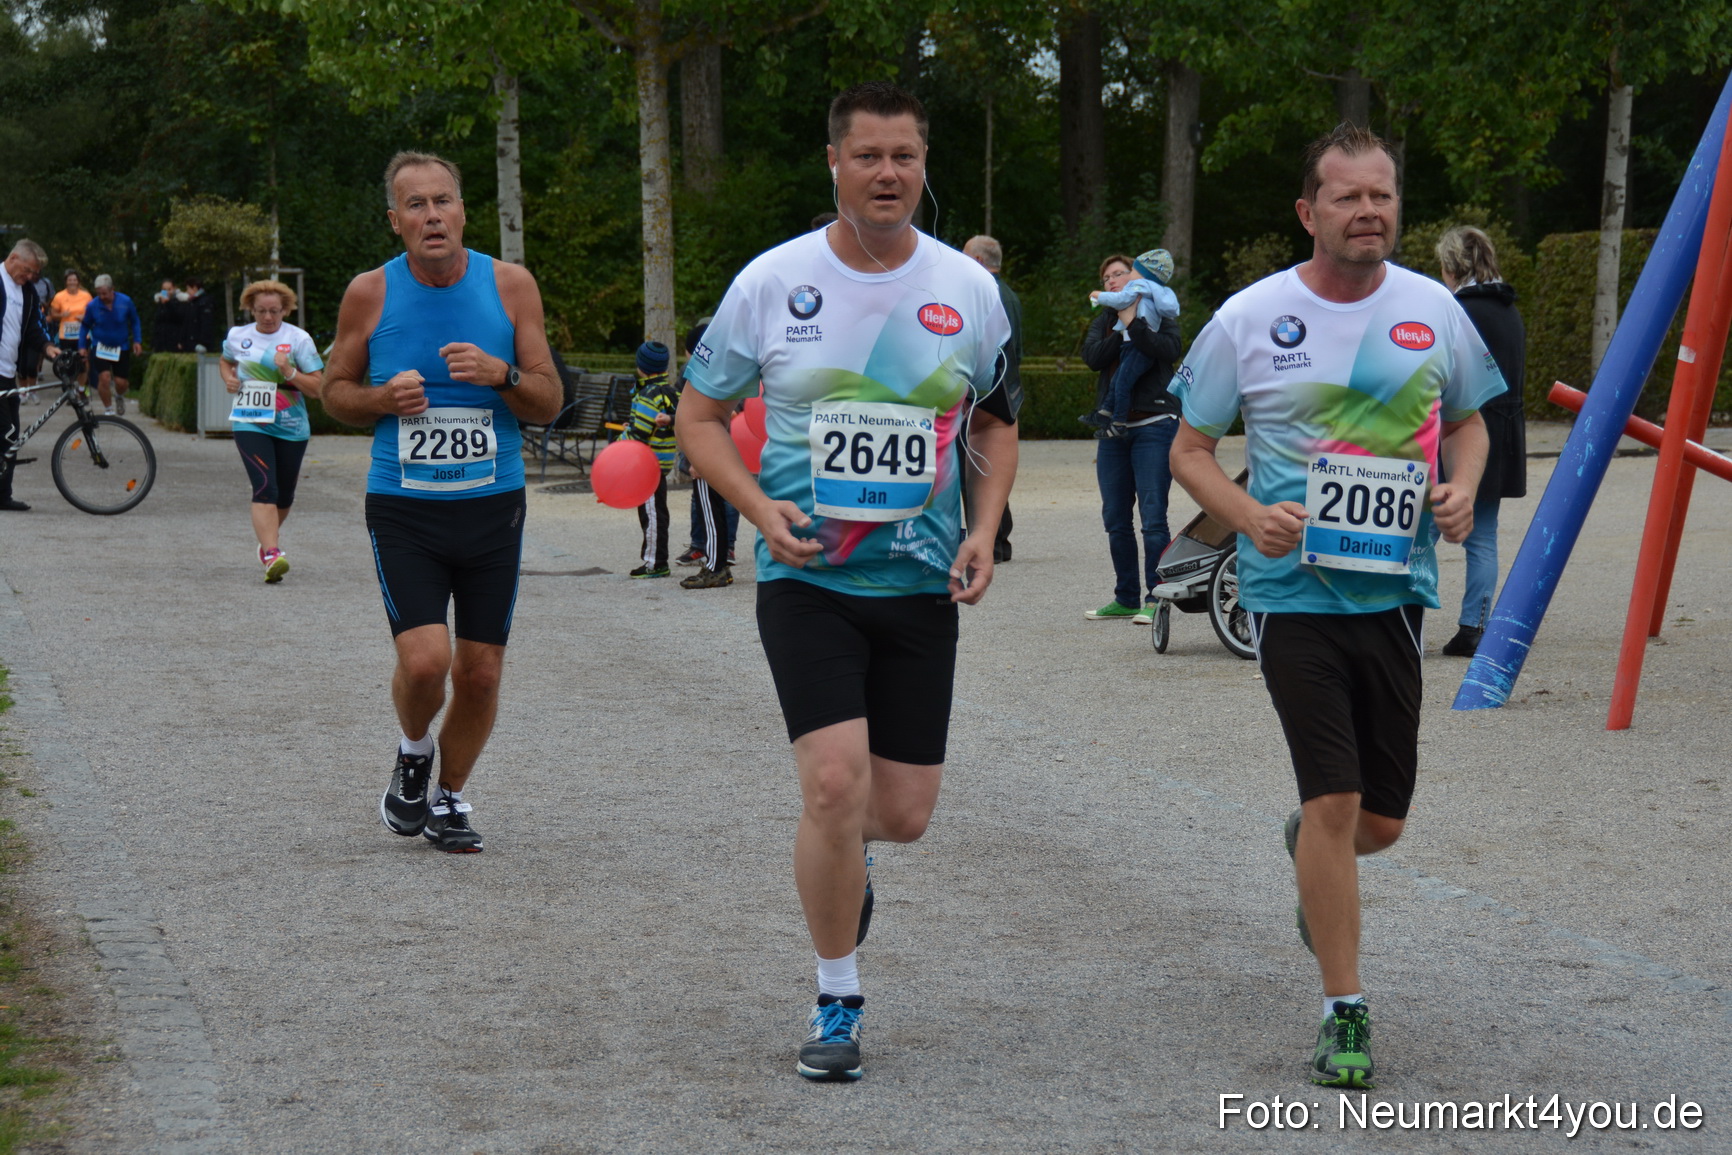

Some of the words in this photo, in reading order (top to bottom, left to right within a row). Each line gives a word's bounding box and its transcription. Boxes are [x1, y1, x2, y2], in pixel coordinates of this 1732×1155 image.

[791, 286, 820, 298] BMW
[1272, 316, 1303, 329] BMW
[785, 325, 823, 336] PARTL
[1395, 328, 1431, 344] Hervis
[785, 335, 823, 343] Neumarkt
[1272, 352, 1312, 365] PARTL
[1274, 361, 1312, 372] Neumarkt
[236, 391, 271, 407] 2100
[401, 417, 433, 427] PARTL
[434, 416, 479, 425] Neumarkt
[814, 413, 856, 425] PARTL
[858, 414, 917, 428] Neumarkt
[409, 428, 489, 460] 2289
[823, 430, 927, 476] 2649
[432, 467, 466, 480] Josef
[1311, 462, 1353, 477] PARTL
[1356, 467, 1411, 483] Neumarkt
[857, 487, 887, 504] Jan
[1318, 481, 1416, 531] 2086
[893, 520, 917, 540] 16.
[1339, 535, 1392, 557] Darius
